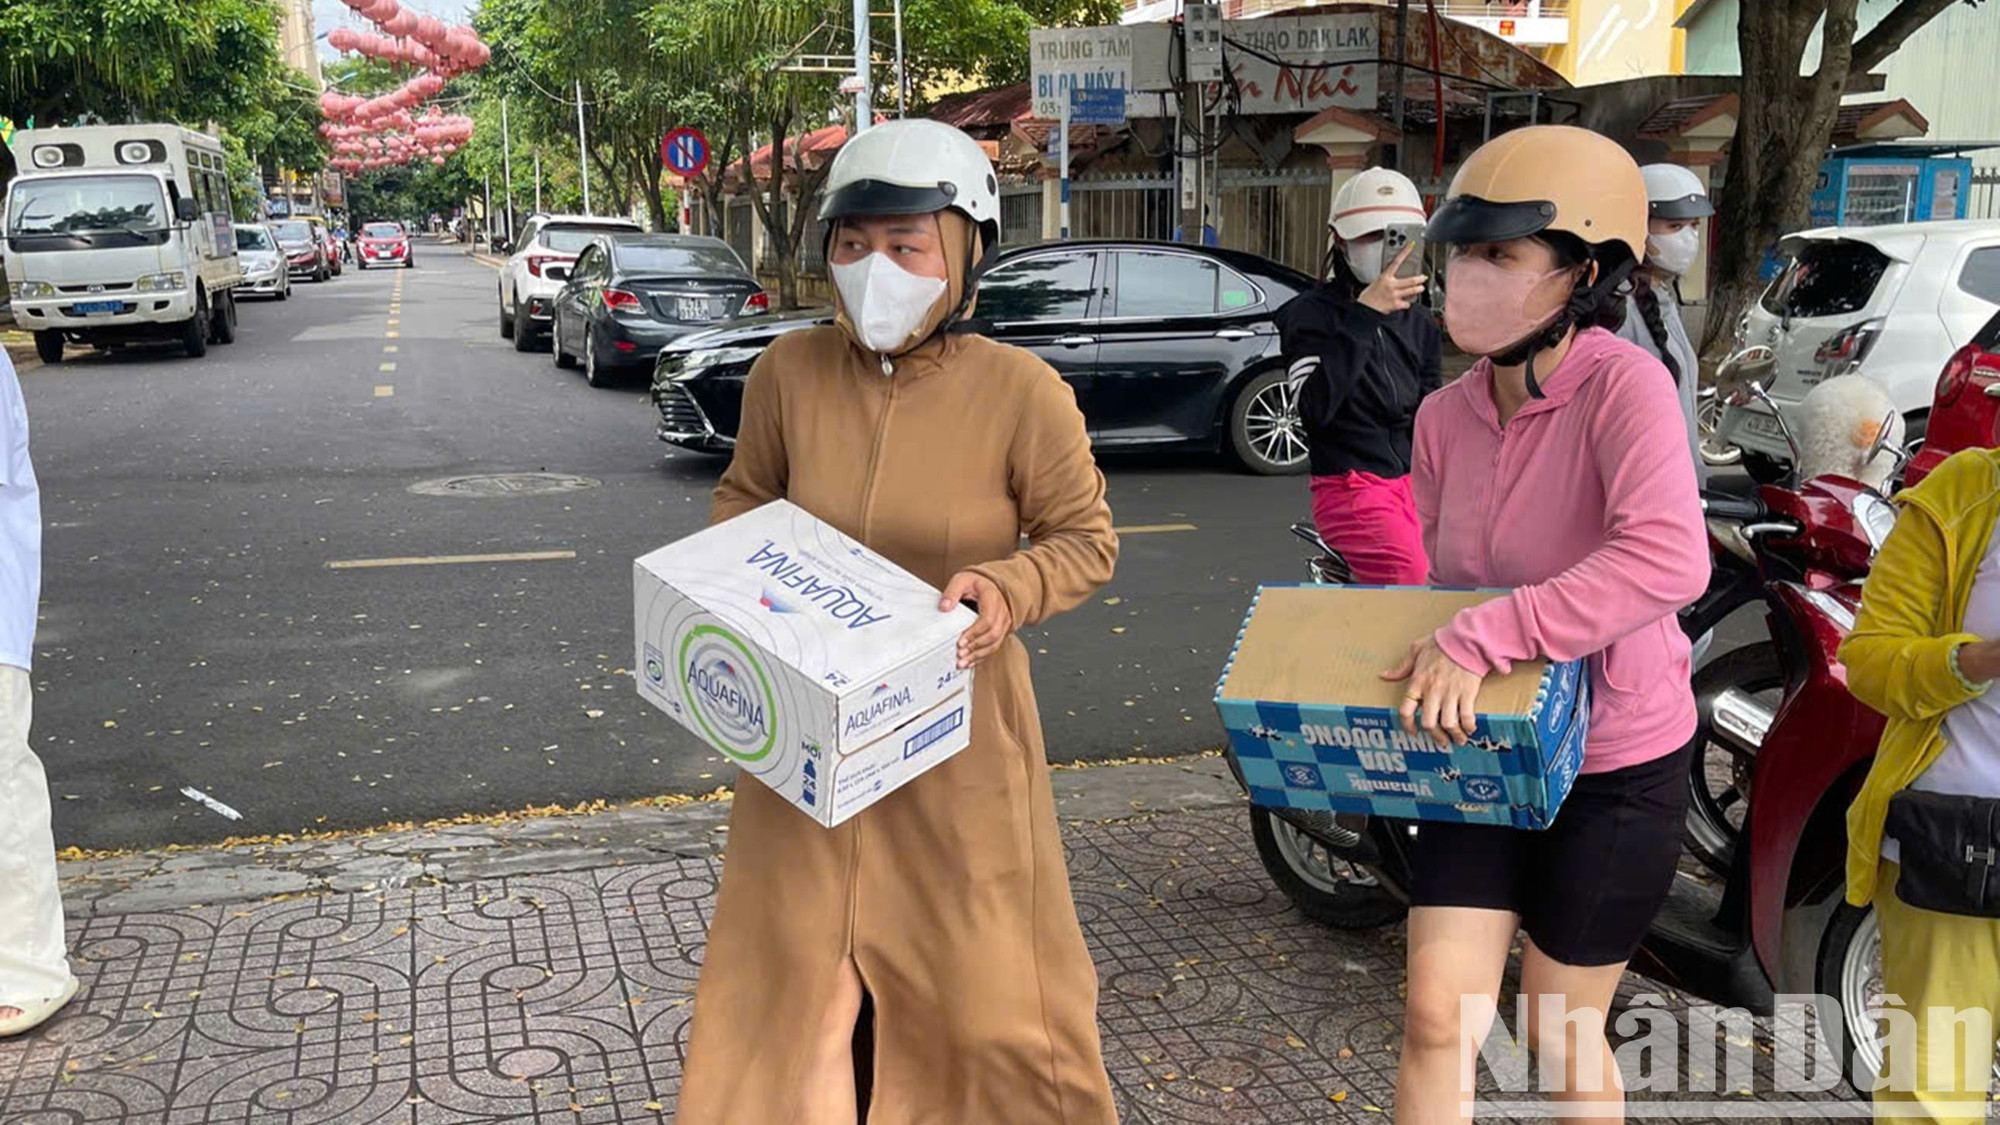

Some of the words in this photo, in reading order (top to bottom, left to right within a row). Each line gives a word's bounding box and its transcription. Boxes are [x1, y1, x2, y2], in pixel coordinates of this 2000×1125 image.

[1038, 40, 1093, 60] TRUNG
[1038, 74, 1053, 98] BI
[1273, 59, 1360, 103] Nhi
[746, 541, 892, 629] AQUAFINA
[937, 671, 952, 689] 24
[687, 660, 769, 737] AQUAFINA
[845, 686, 913, 737] AQUAFINA
[1351, 777, 1434, 797] Vinamilk
